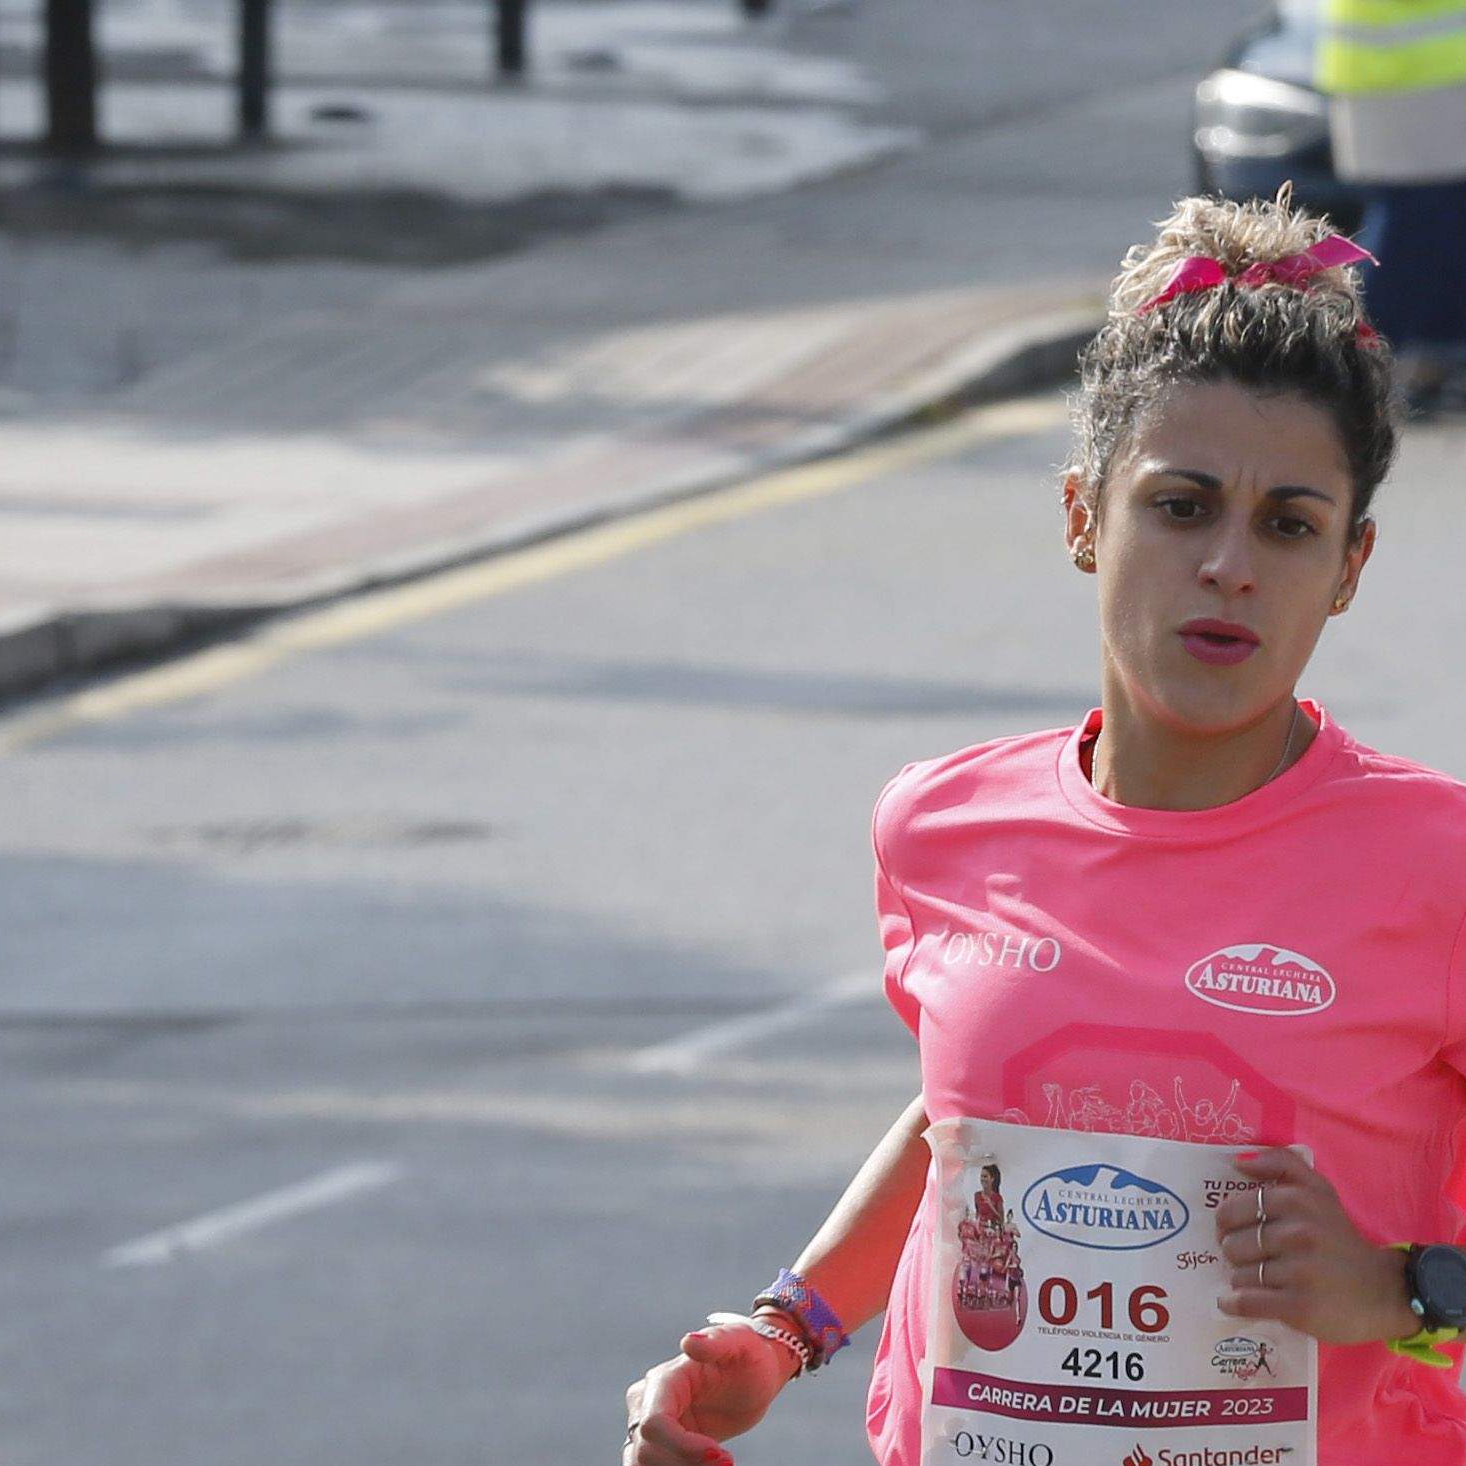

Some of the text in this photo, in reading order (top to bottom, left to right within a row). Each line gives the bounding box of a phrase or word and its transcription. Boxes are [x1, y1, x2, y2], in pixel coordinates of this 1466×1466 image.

[943, 931, 1062, 972] OYSHO
[1194, 963, 1323, 1004] ASTURIANA
[1221, 962, 1321, 982] CENTRAL LECHERA
[1058, 1189, 1169, 1205] CENTRAL LECHERA
[1204, 1180, 1221, 1190] TU
[1032, 1189, 1176, 1231] ASTURIANA
[1038, 1277, 1170, 1333] 016
[1081, 1330, 1121, 1340] VIOLENCIA
[1122, 1333, 1133, 1342] DE
[1061, 1347, 1144, 1381] 4216
[967, 1383, 1274, 1418] CARRERA DE LA MUJER 2023
